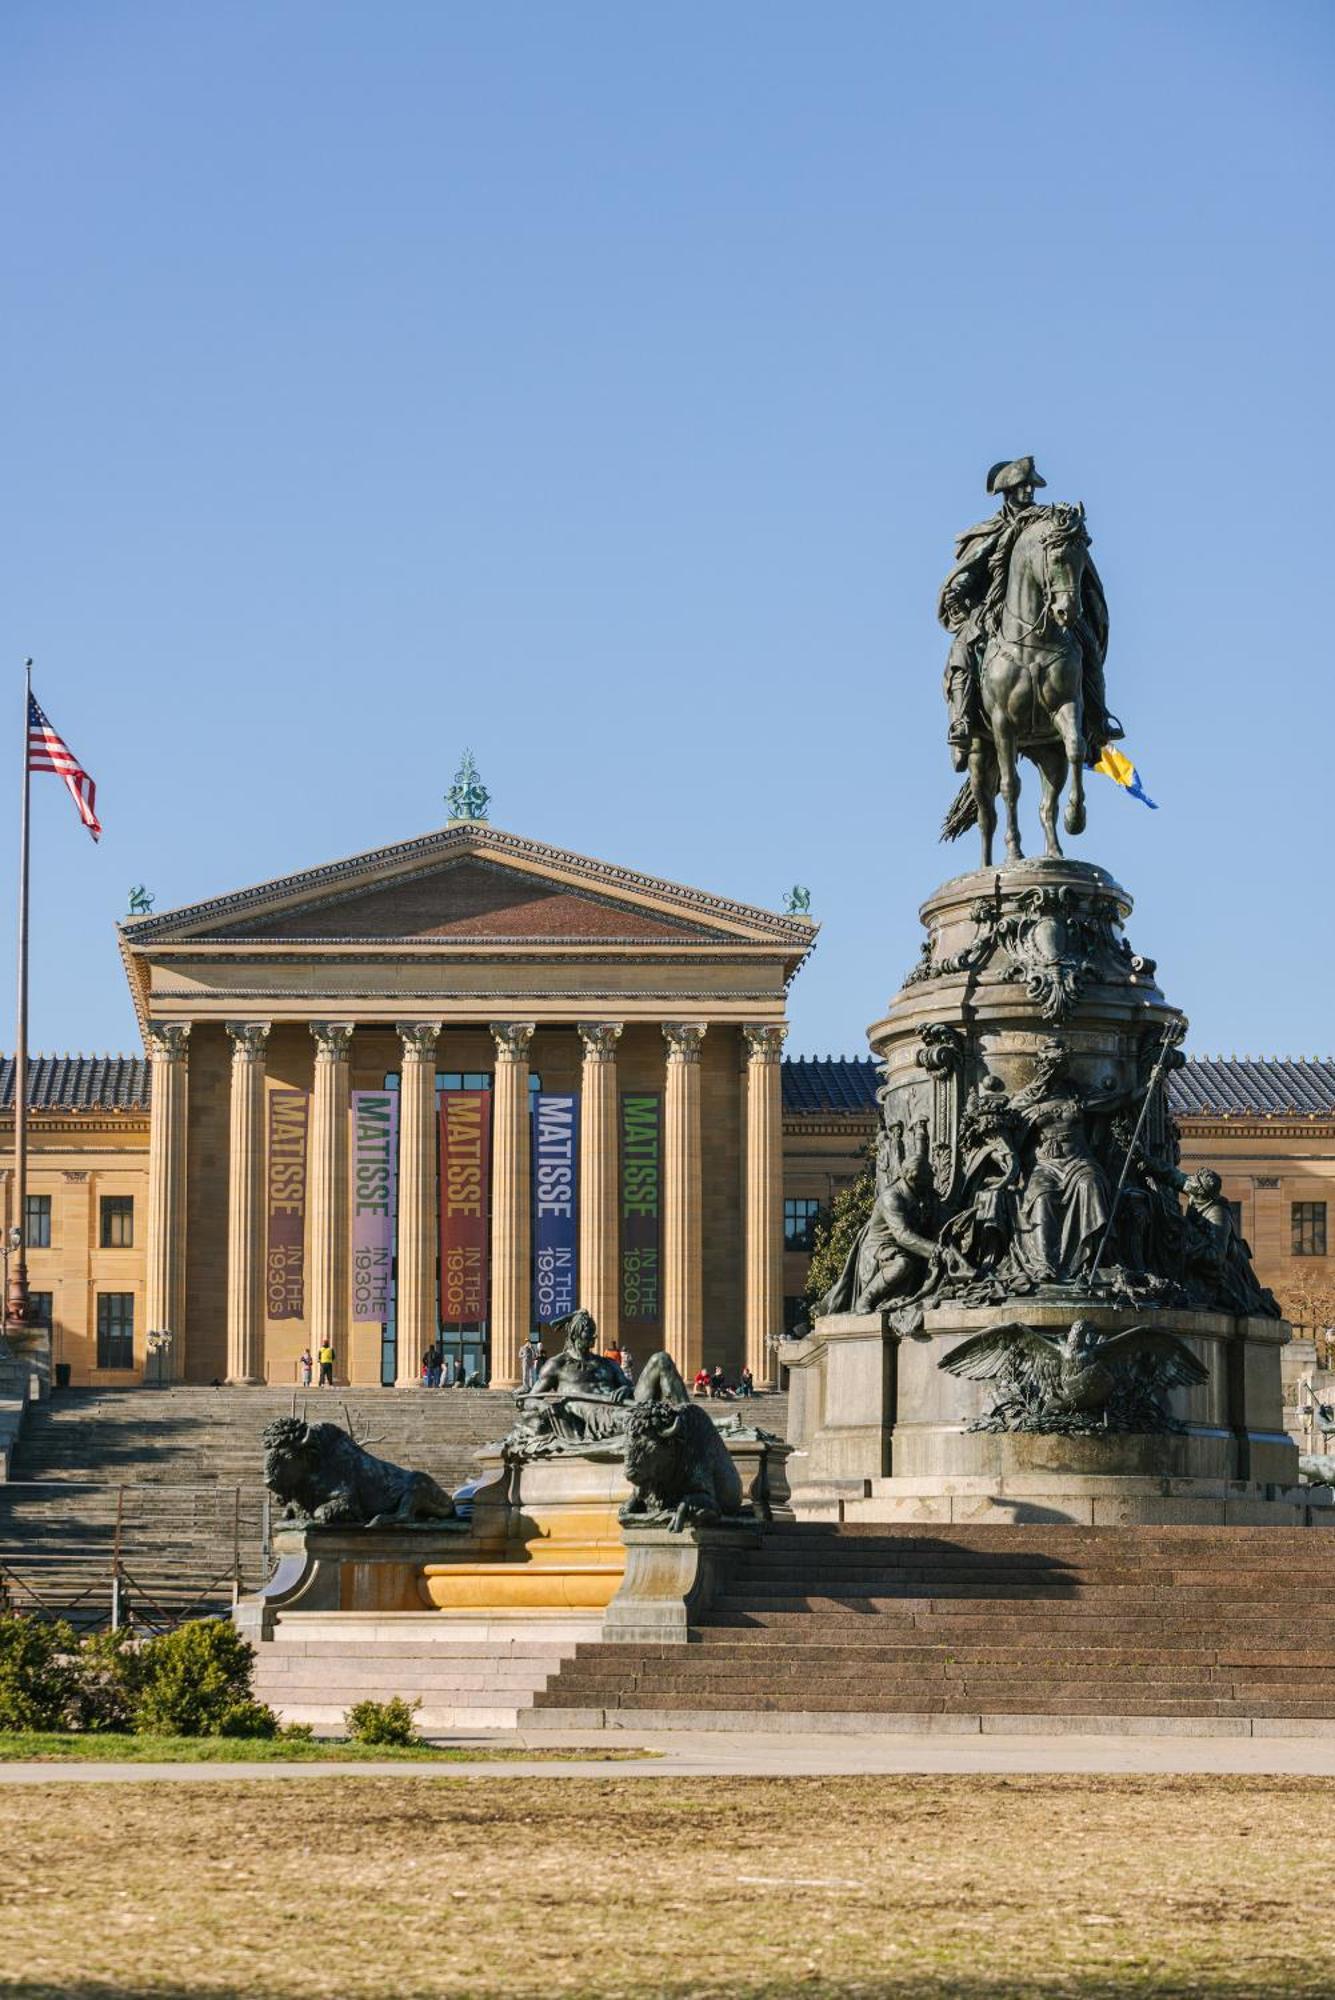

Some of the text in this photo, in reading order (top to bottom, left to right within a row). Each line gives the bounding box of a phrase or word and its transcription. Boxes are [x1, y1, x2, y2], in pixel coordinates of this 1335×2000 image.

[270, 1096, 306, 1216] MATISSE
[356, 1097, 391, 1217] MATISSE
[447, 1097, 481, 1217] MATISSE
[537, 1097, 573, 1218] MATISSE
[623, 1097, 658, 1218] MATISSE
[269, 1245, 285, 1313] 1930s
[286, 1246, 303, 1311] IN THE
[355, 1247, 372, 1315] 1930s
[371, 1248, 389, 1313] IN THE
[447, 1247, 464, 1316] 1930s
[464, 1248, 481, 1314] IN THE
[537, 1247, 555, 1316] 1930s
[555, 1248, 571, 1314] IN THE
[623, 1248, 640, 1317] 1930s
[641, 1248, 657, 1315] IN THE
